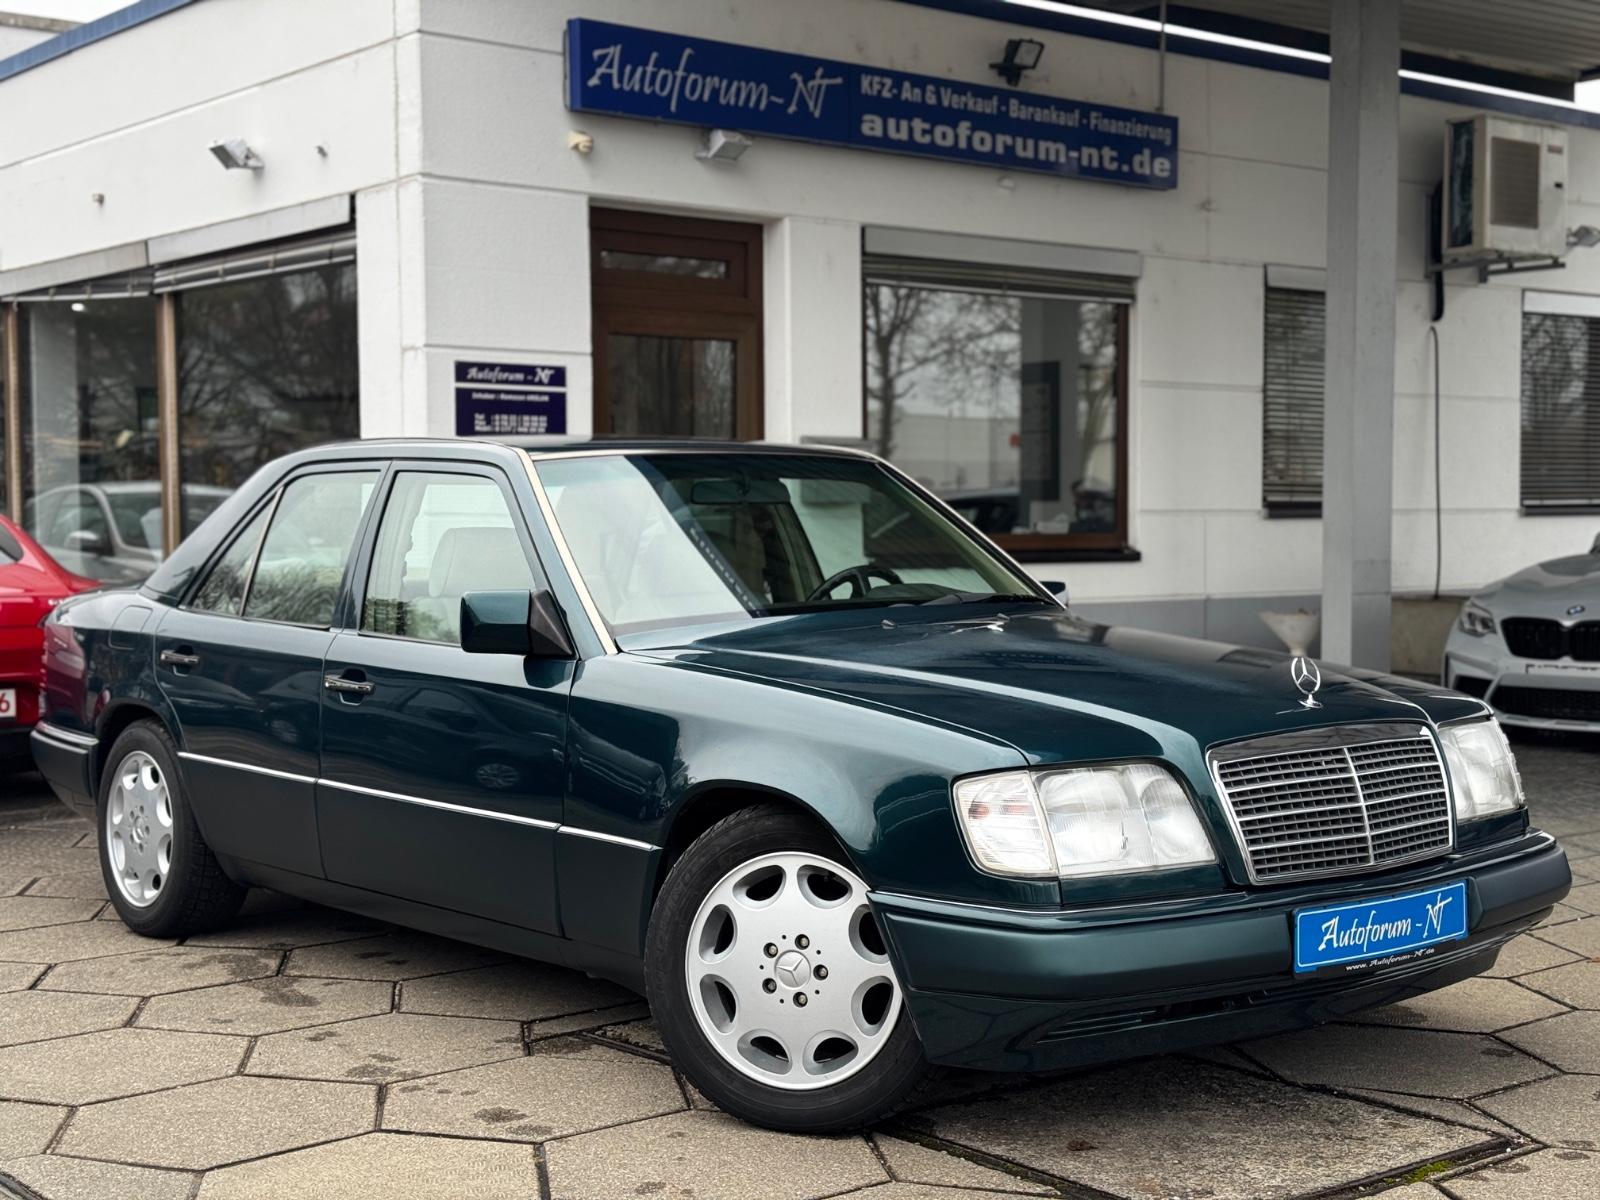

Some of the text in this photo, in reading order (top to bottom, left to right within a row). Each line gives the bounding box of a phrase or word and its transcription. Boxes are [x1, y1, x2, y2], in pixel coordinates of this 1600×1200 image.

[860, 113, 1171, 178] autoforum-nt.de
[901, 80, 922, 103] An
[925, 84, 938, 106] &
[940, 86, 999, 115] Verkauf
[1009, 98, 1080, 128] Barankauf
[1089, 111, 1172, 146] Finanzierung
